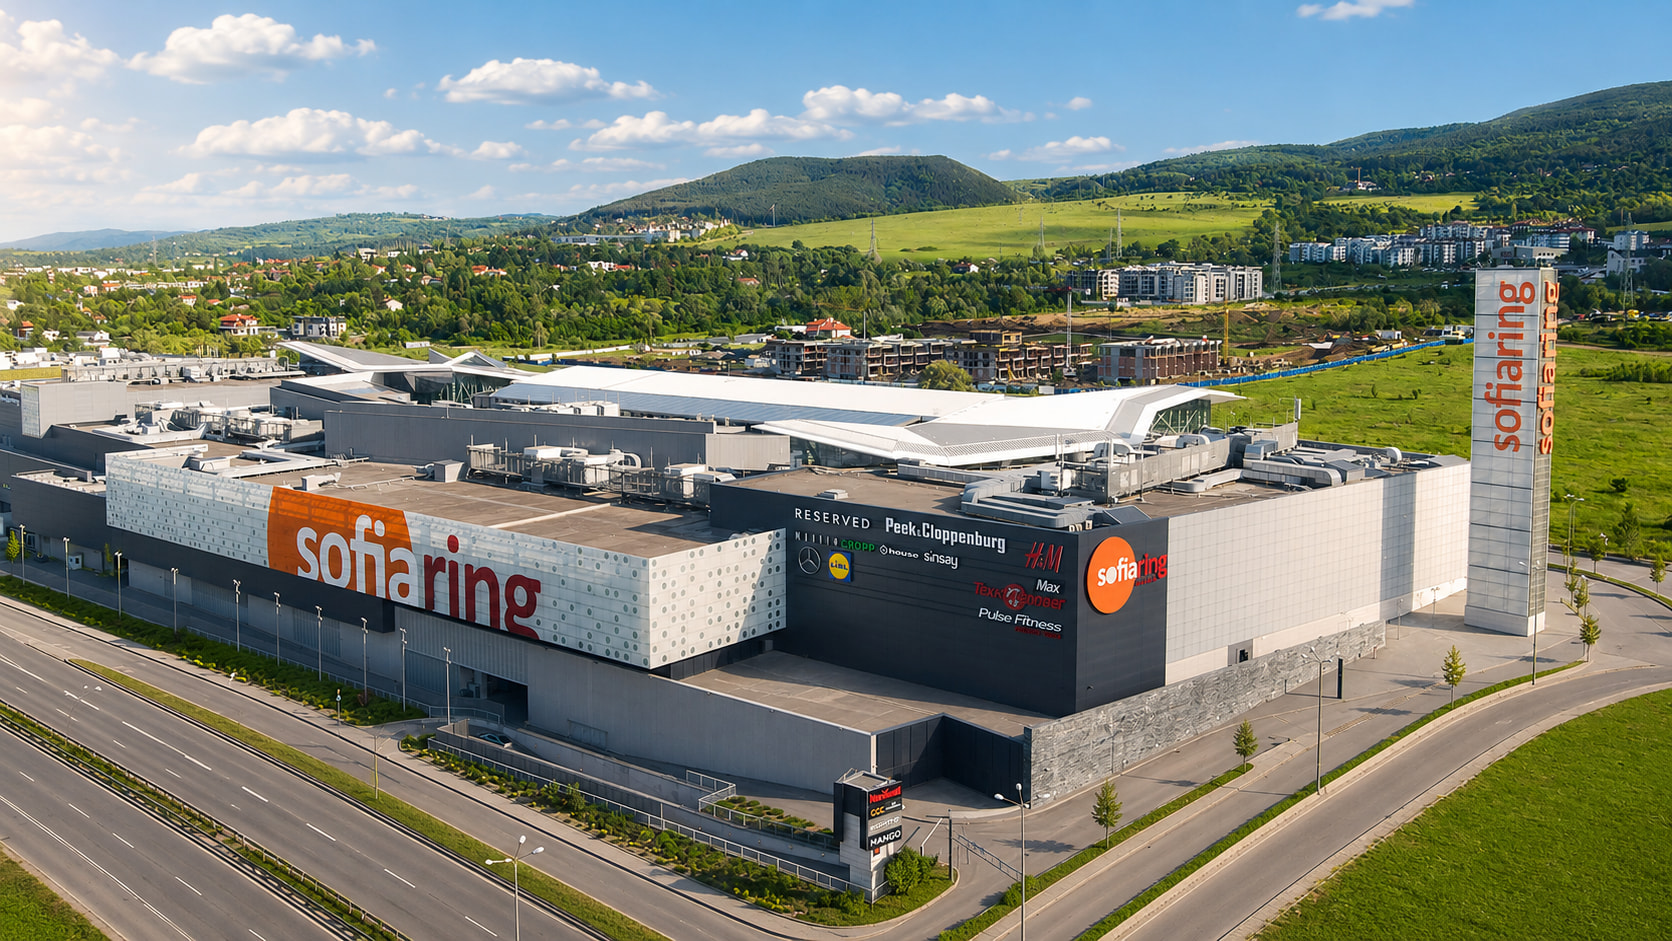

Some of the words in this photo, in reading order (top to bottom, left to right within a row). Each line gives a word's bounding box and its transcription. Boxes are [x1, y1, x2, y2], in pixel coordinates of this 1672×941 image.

[1484, 280, 1535, 452] sofiaring
[795, 508, 870, 529] RESERVED
[923, 550, 959, 570] sinsay
[296, 514, 542, 641] sofiaring
[1036, 579, 1061, 594] Max
[978, 607, 1013, 623] Pulse
[1014, 613, 1063, 632] Fitness
[870, 830, 901, 847] MANGO
